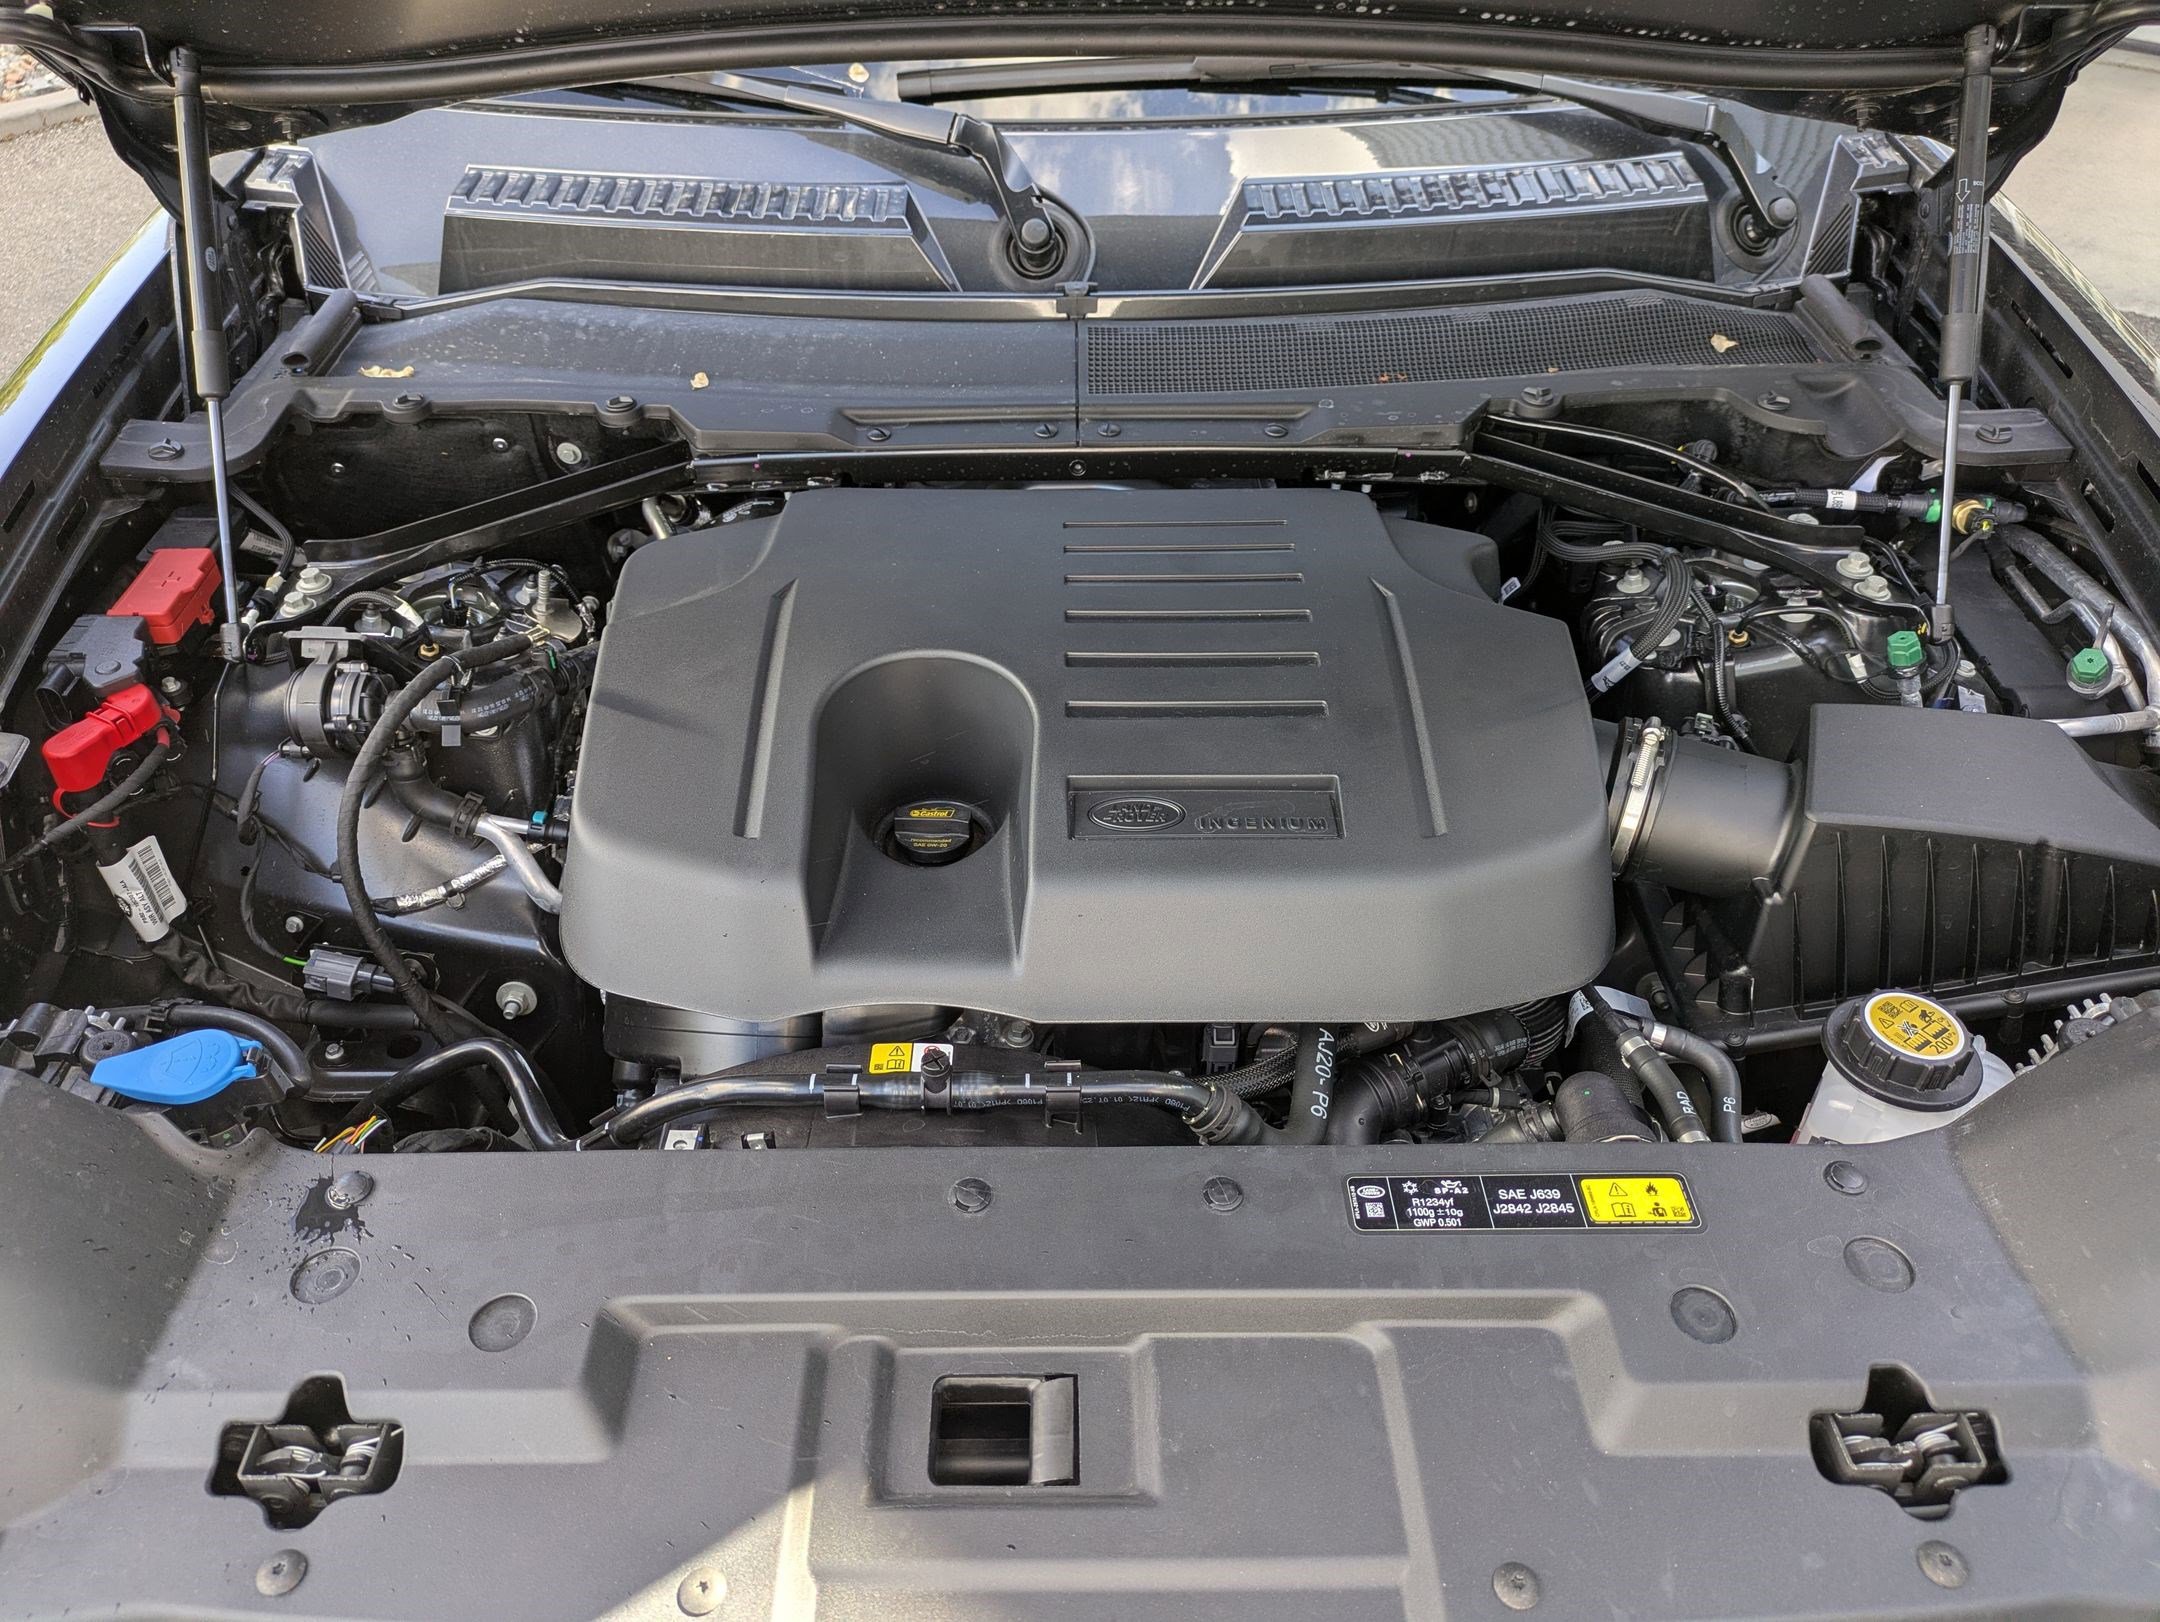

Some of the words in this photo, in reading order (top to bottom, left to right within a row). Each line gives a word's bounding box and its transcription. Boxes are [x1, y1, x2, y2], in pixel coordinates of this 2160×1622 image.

[1199, 816, 1326, 831] INGENIUM
[1929, 1036, 1954, 1055] 200
[1676, 1090, 1697, 1115] RAD
[1723, 1096, 1737, 1114] P6
[1434, 1187, 1469, 1195] SP-A2
[1498, 1188, 1527, 1200] SAE
[1529, 1188, 1561, 1200] J639
[1411, 1197, 1455, 1208] R1234yf
[1493, 1203, 1533, 1214] J2842
[1535, 1202, 1575, 1213] J2845
[1407, 1208, 1435, 1218] 1100g
[1437, 1208, 1464, 1218] ±10g
[1413, 1218, 1436, 1228] GWP
[1438, 1218, 1462, 1227] 0.501
